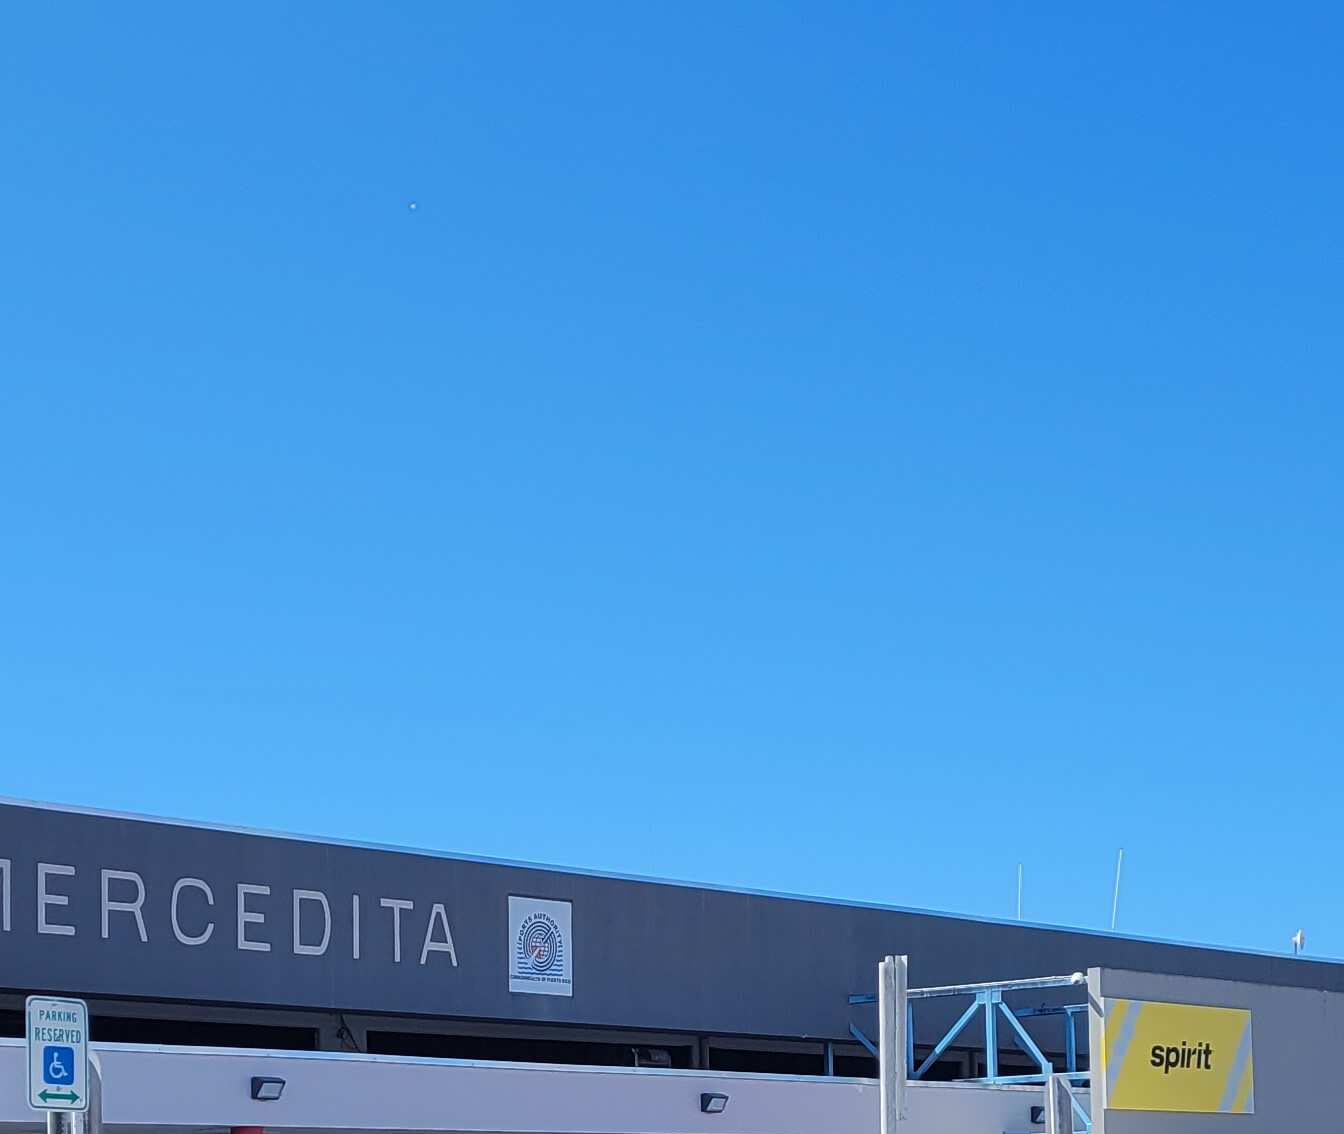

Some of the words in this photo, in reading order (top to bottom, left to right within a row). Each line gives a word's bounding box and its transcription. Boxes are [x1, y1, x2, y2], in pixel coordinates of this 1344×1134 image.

[518, 916, 533, 946] PORTS
[534, 912, 563, 945] AUTHORITY
[39, 1010, 77, 1023] PARKING
[35, 1027, 82, 1043] RESERVED
[1150, 1041, 1212, 1074] spirit
